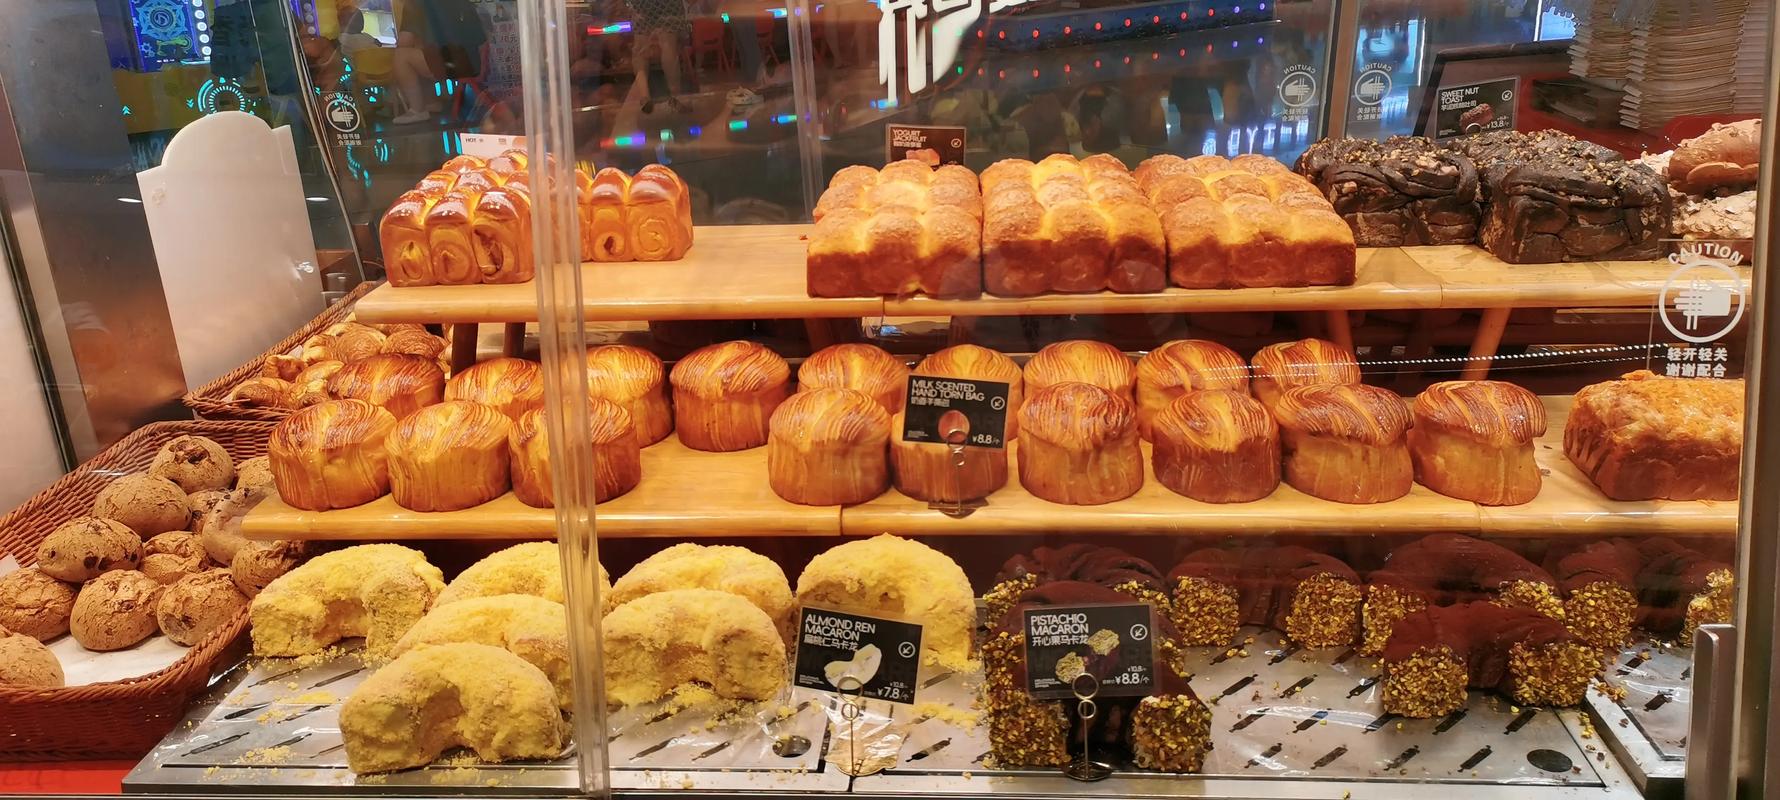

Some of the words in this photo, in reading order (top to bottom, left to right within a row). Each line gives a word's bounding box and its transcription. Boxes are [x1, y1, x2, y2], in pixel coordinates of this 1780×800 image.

[1441, 88, 1465, 98] SWEET
[1465, 86, 1480, 95] NUT
[1441, 95, 1464, 104] TOAST
[893, 129, 921, 137] YOGURT
[1668, 243, 1744, 265] CAUTION
[1667, 347, 1728, 362] 轻开轻关
[1666, 363, 1727, 378] 谢谢配合
[912, 379, 934, 390] MILK
[935, 380, 977, 392] SCENTED
[911, 389, 937, 398] HAND
[940, 391, 964, 401] TORN
[965, 391, 985, 402] BAG
[805, 613, 853, 630] ALMOND
[854, 621, 876, 634] REN
[1031, 613, 1087, 626] PISTACHIO
[805, 623, 860, 642] MACARON
[1031, 623, 1089, 636] MACARON
[1032, 635, 1089, 647] 开心果马卡龙
